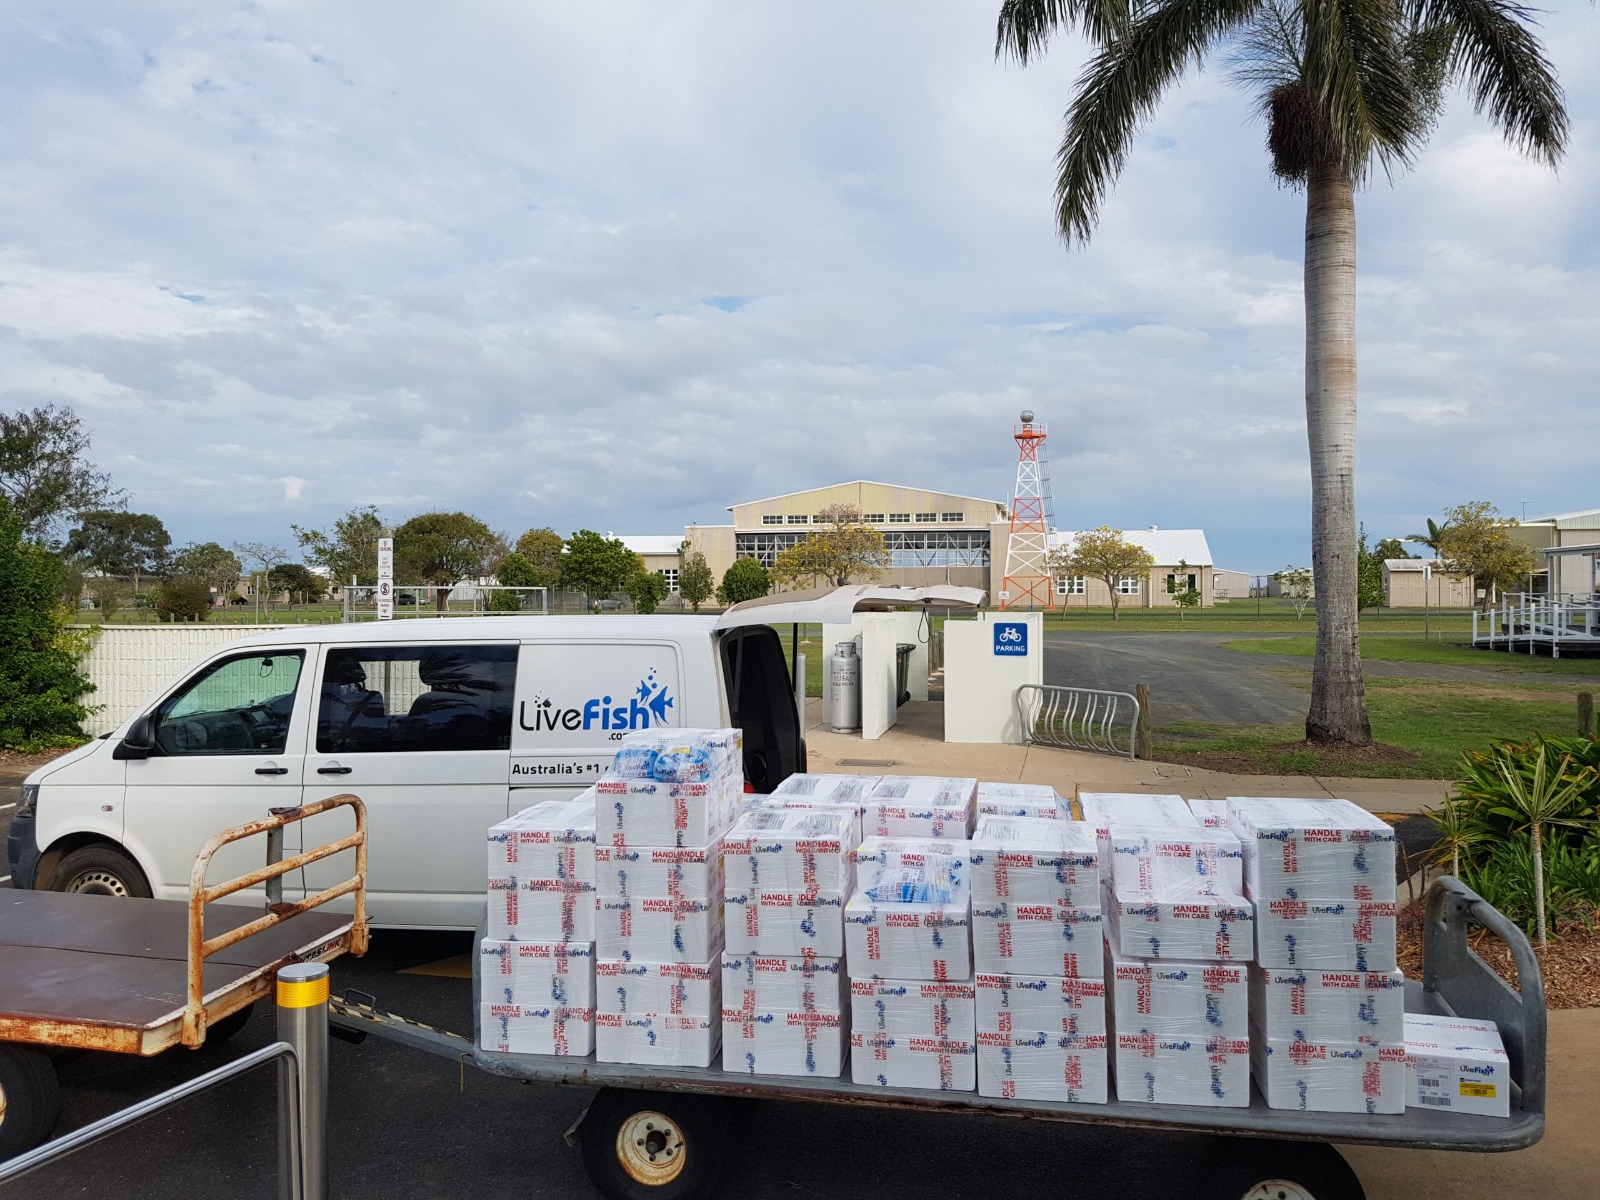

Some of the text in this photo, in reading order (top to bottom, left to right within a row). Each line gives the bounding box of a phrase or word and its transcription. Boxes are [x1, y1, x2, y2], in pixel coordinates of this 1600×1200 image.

[609, 732, 628, 740] .co
[512, 762, 582, 774] Australia's
[586, 764, 599, 774] #1
[631, 786, 653, 794] LiveFish
[1257, 833, 1284, 841] LiveFish
[1139, 857, 1147, 889] HANDLE
[1173, 905, 1210, 913] HANDLE
[886, 914, 919, 922] HANDLE
[998, 923, 1007, 957] HANDLE
[977, 975, 1012, 983] HANDLE
[1157, 972, 1184, 981] LiveFish
[1322, 974, 1360, 982] HANDLE
[1017, 982, 1043, 990] LiveFish
[977, 1032, 1011, 1040] HANDLE
[1016, 1040, 1042, 1048] LiveFish
[1160, 1042, 1187, 1050] LiveFish
[1331, 1051, 1359, 1059] LiveFish
[1460, 1065, 1490, 1076] LiveFish
